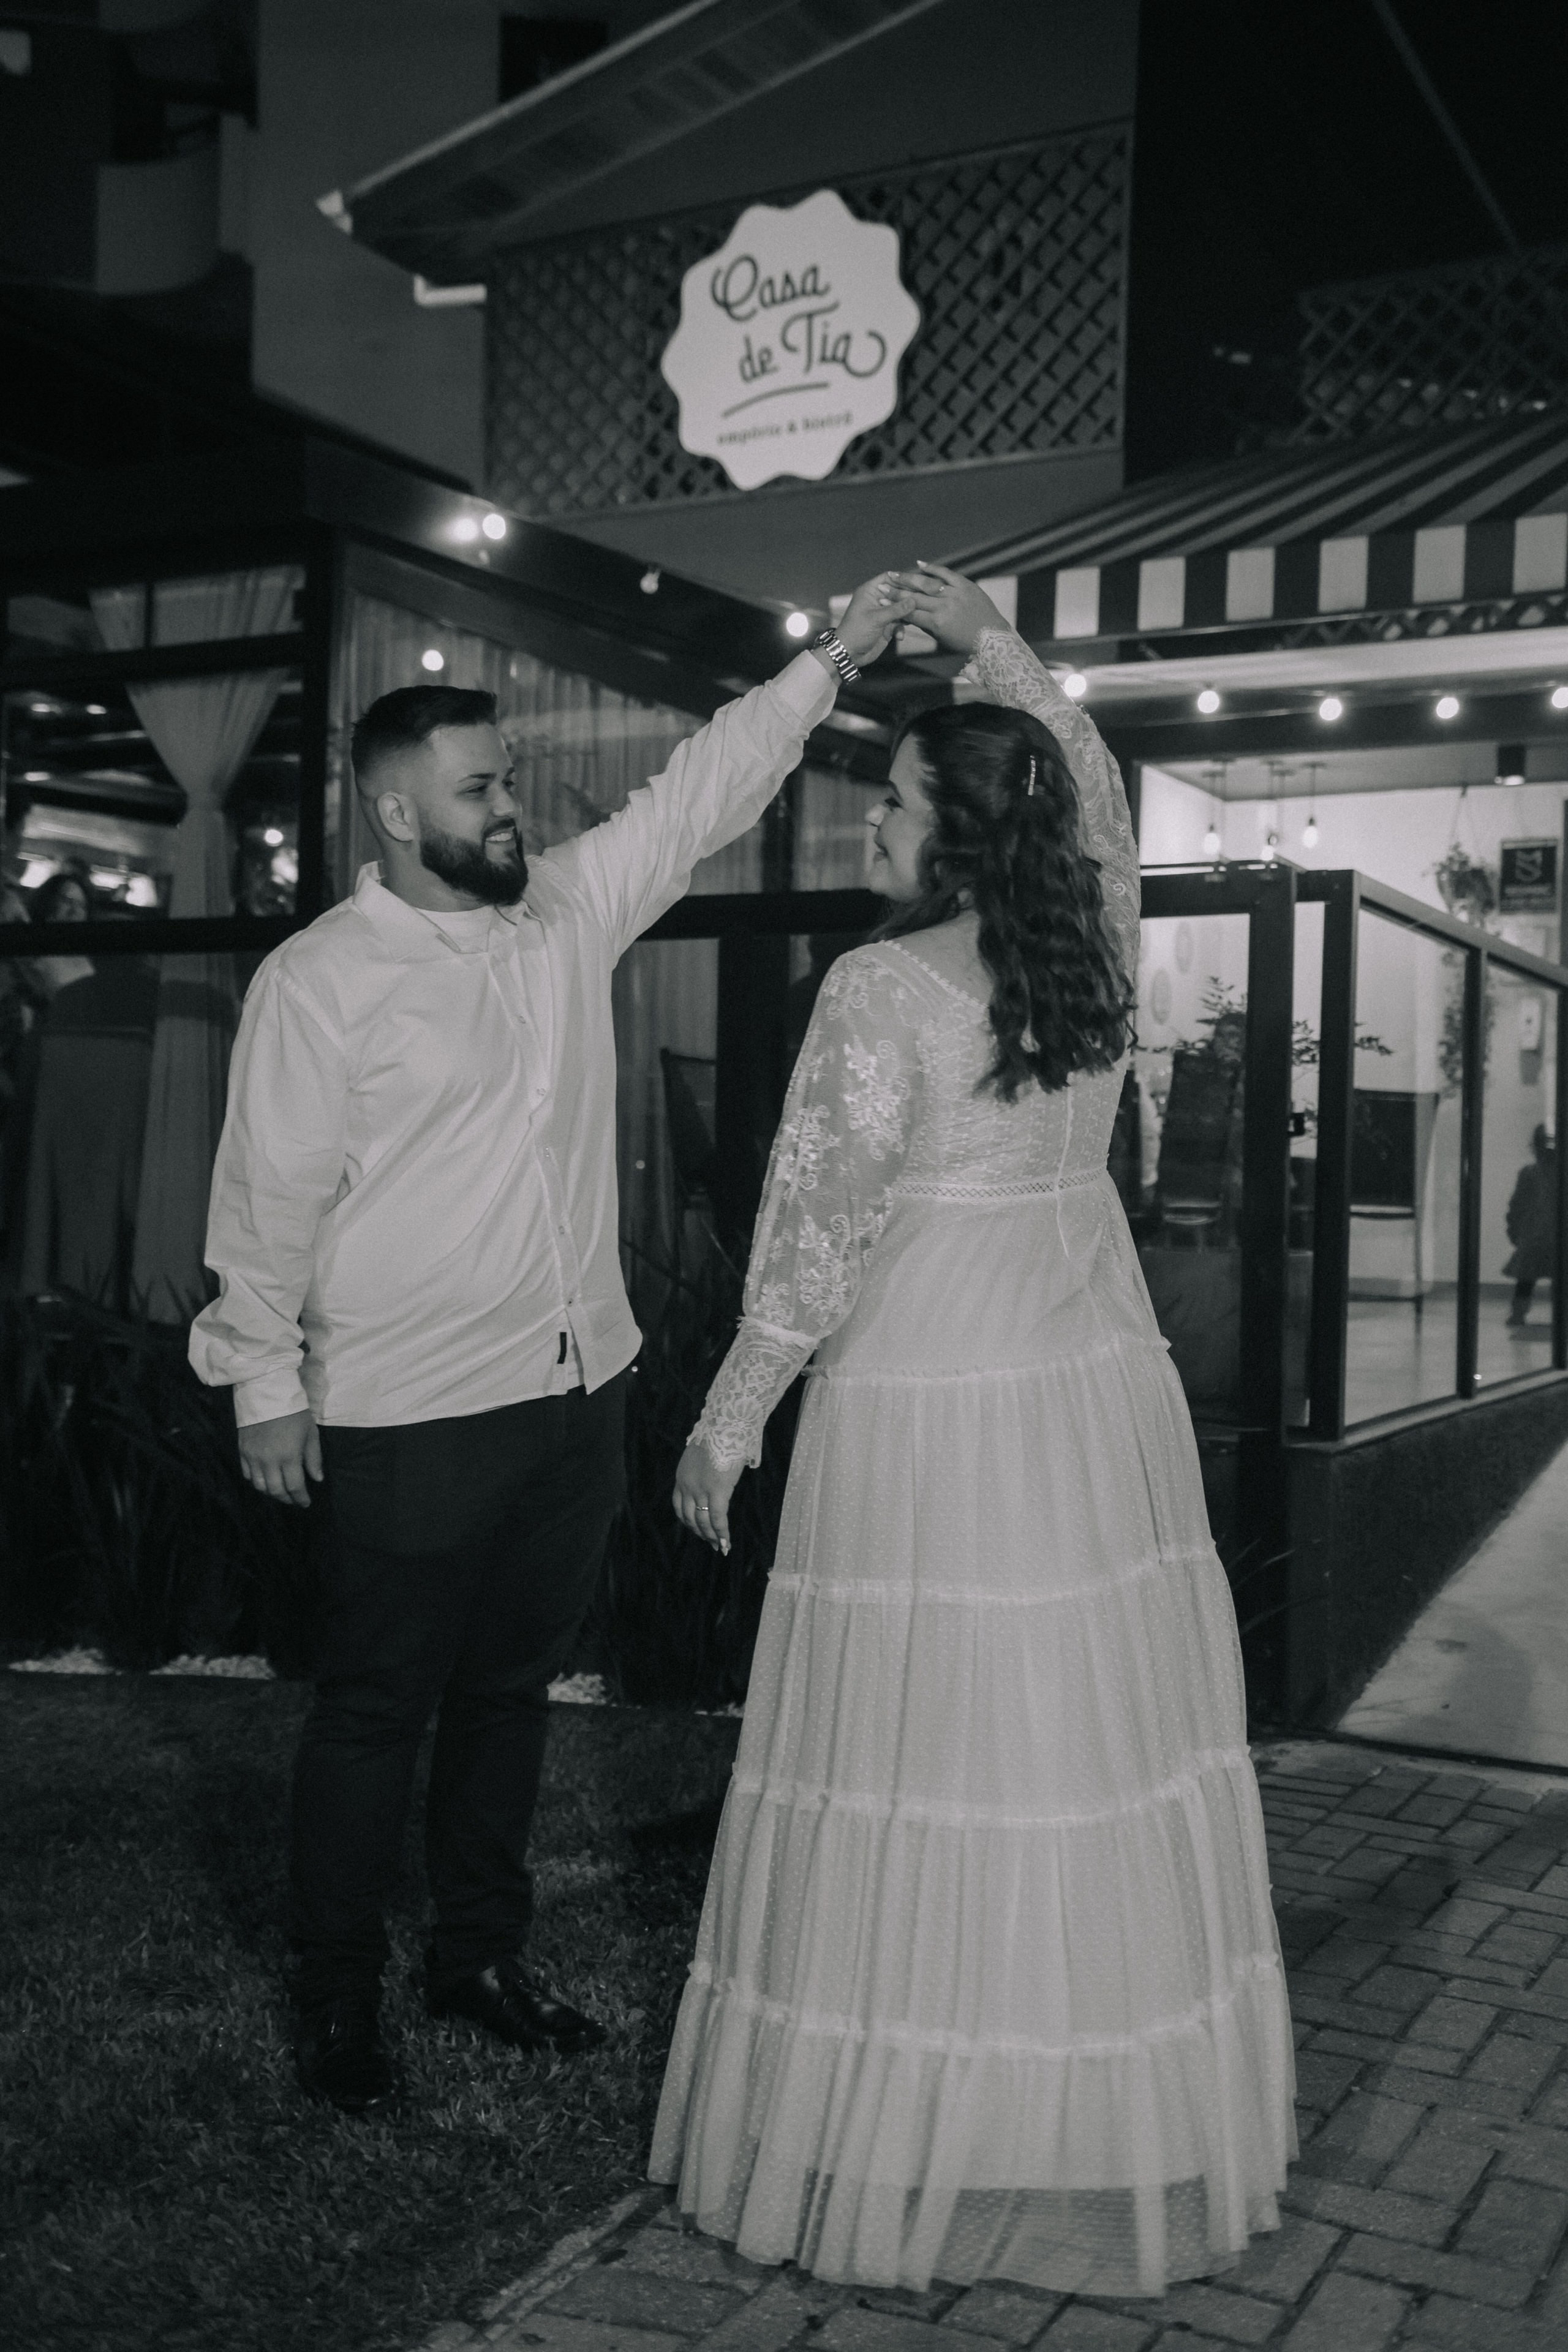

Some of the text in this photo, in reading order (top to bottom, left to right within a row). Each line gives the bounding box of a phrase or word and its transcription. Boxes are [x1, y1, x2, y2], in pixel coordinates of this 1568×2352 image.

[711, 254, 832, 322] Casa
[739, 301, 888, 383] de Tia
